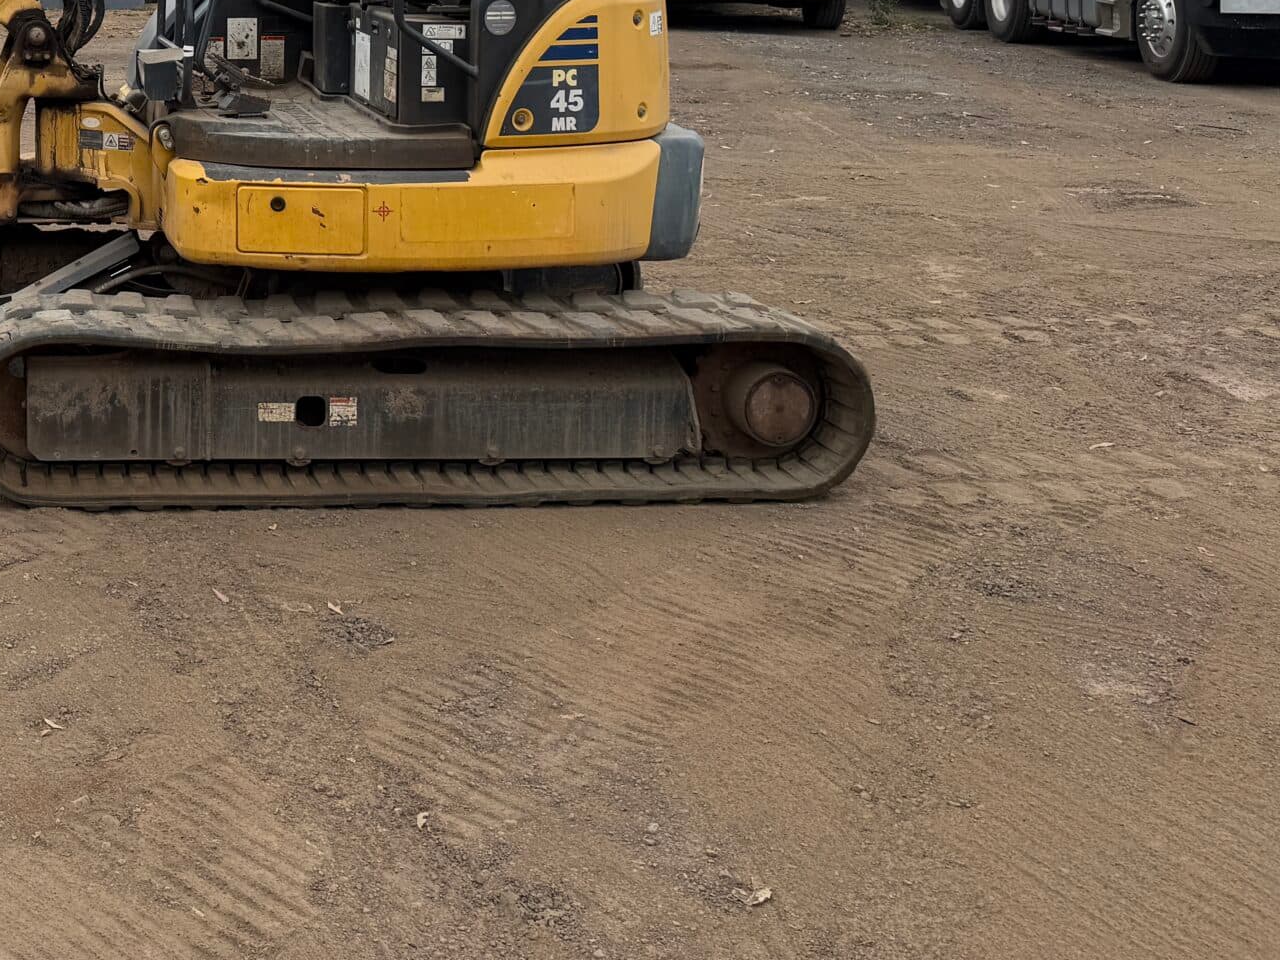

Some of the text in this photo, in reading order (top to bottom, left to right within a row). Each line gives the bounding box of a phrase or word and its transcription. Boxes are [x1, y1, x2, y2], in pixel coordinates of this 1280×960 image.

[552, 69, 578, 87] PC
[550, 89, 584, 113] 45
[551, 116, 577, 132] MR
